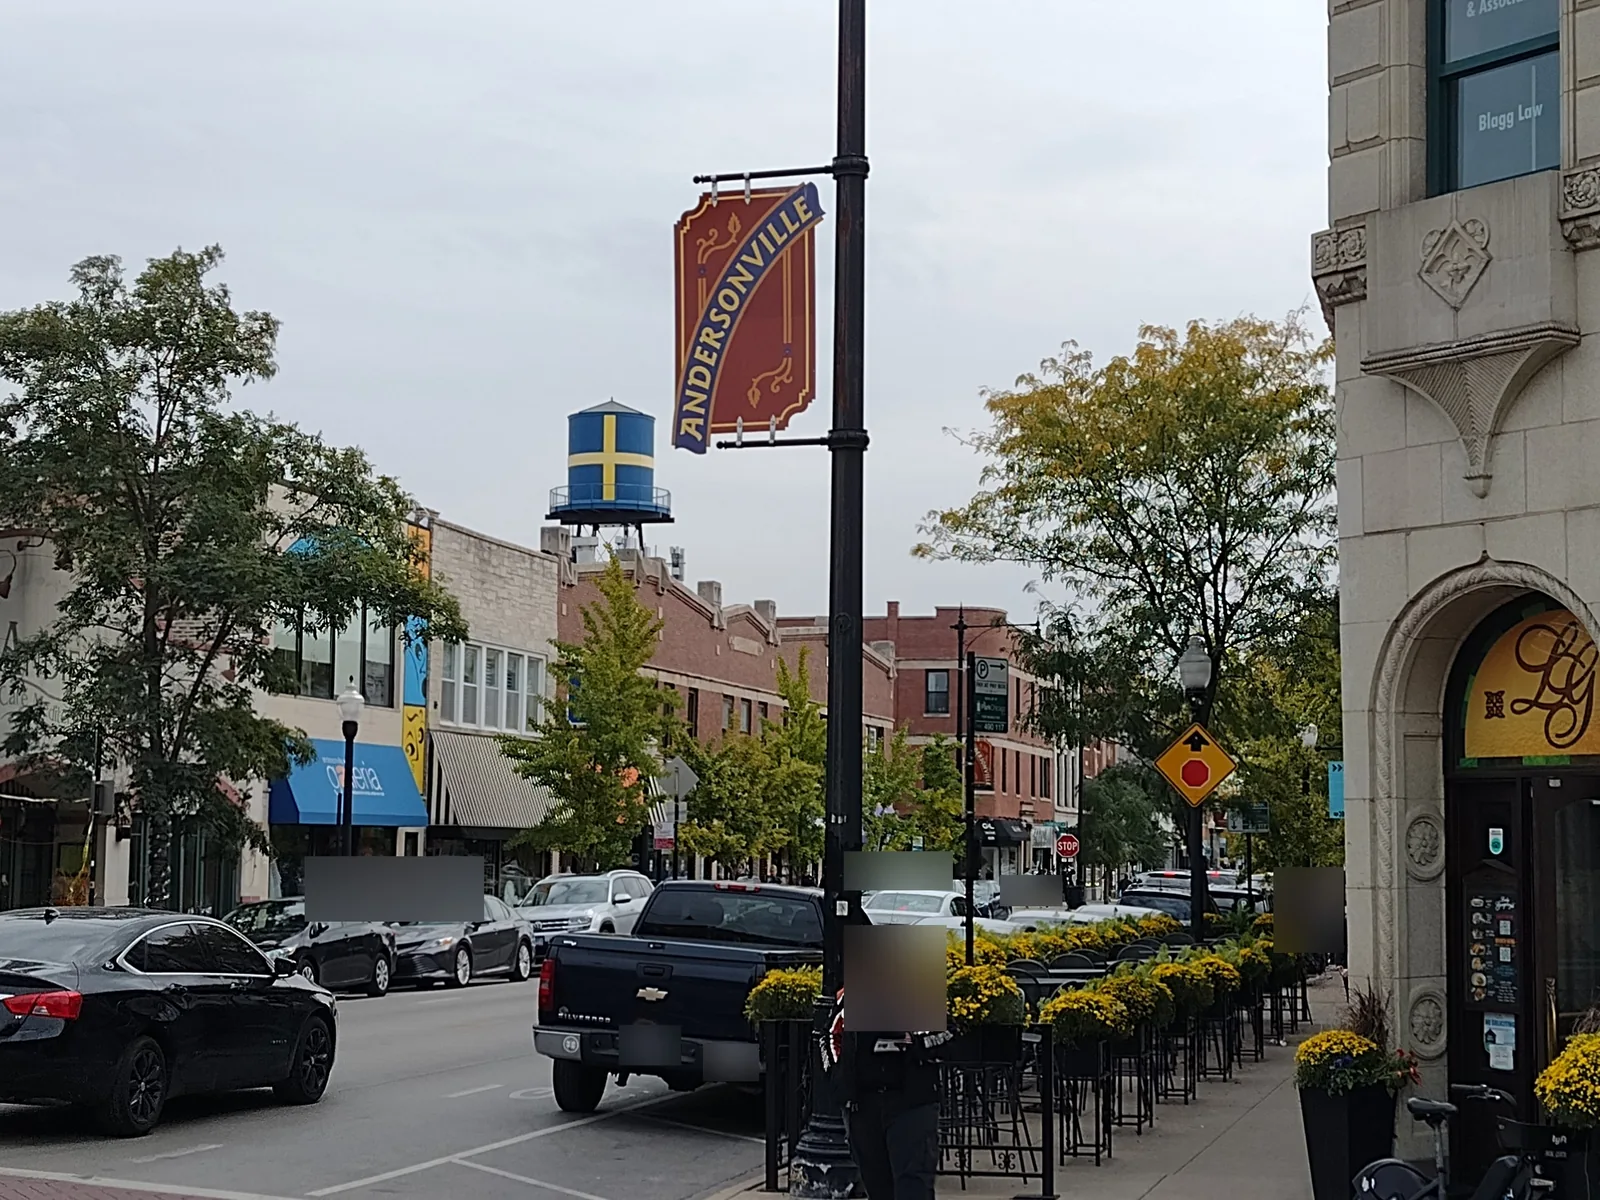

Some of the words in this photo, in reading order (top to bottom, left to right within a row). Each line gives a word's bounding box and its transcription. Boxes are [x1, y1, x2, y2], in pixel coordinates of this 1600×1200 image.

[1466, 1, 1476, 17] &
[1478, 111, 1515, 131] Blagg
[1518, 103, 1543, 121] Law
[680, 196, 813, 441] ANDERSONVILLE
[1057, 843, 1078, 851] STOP
